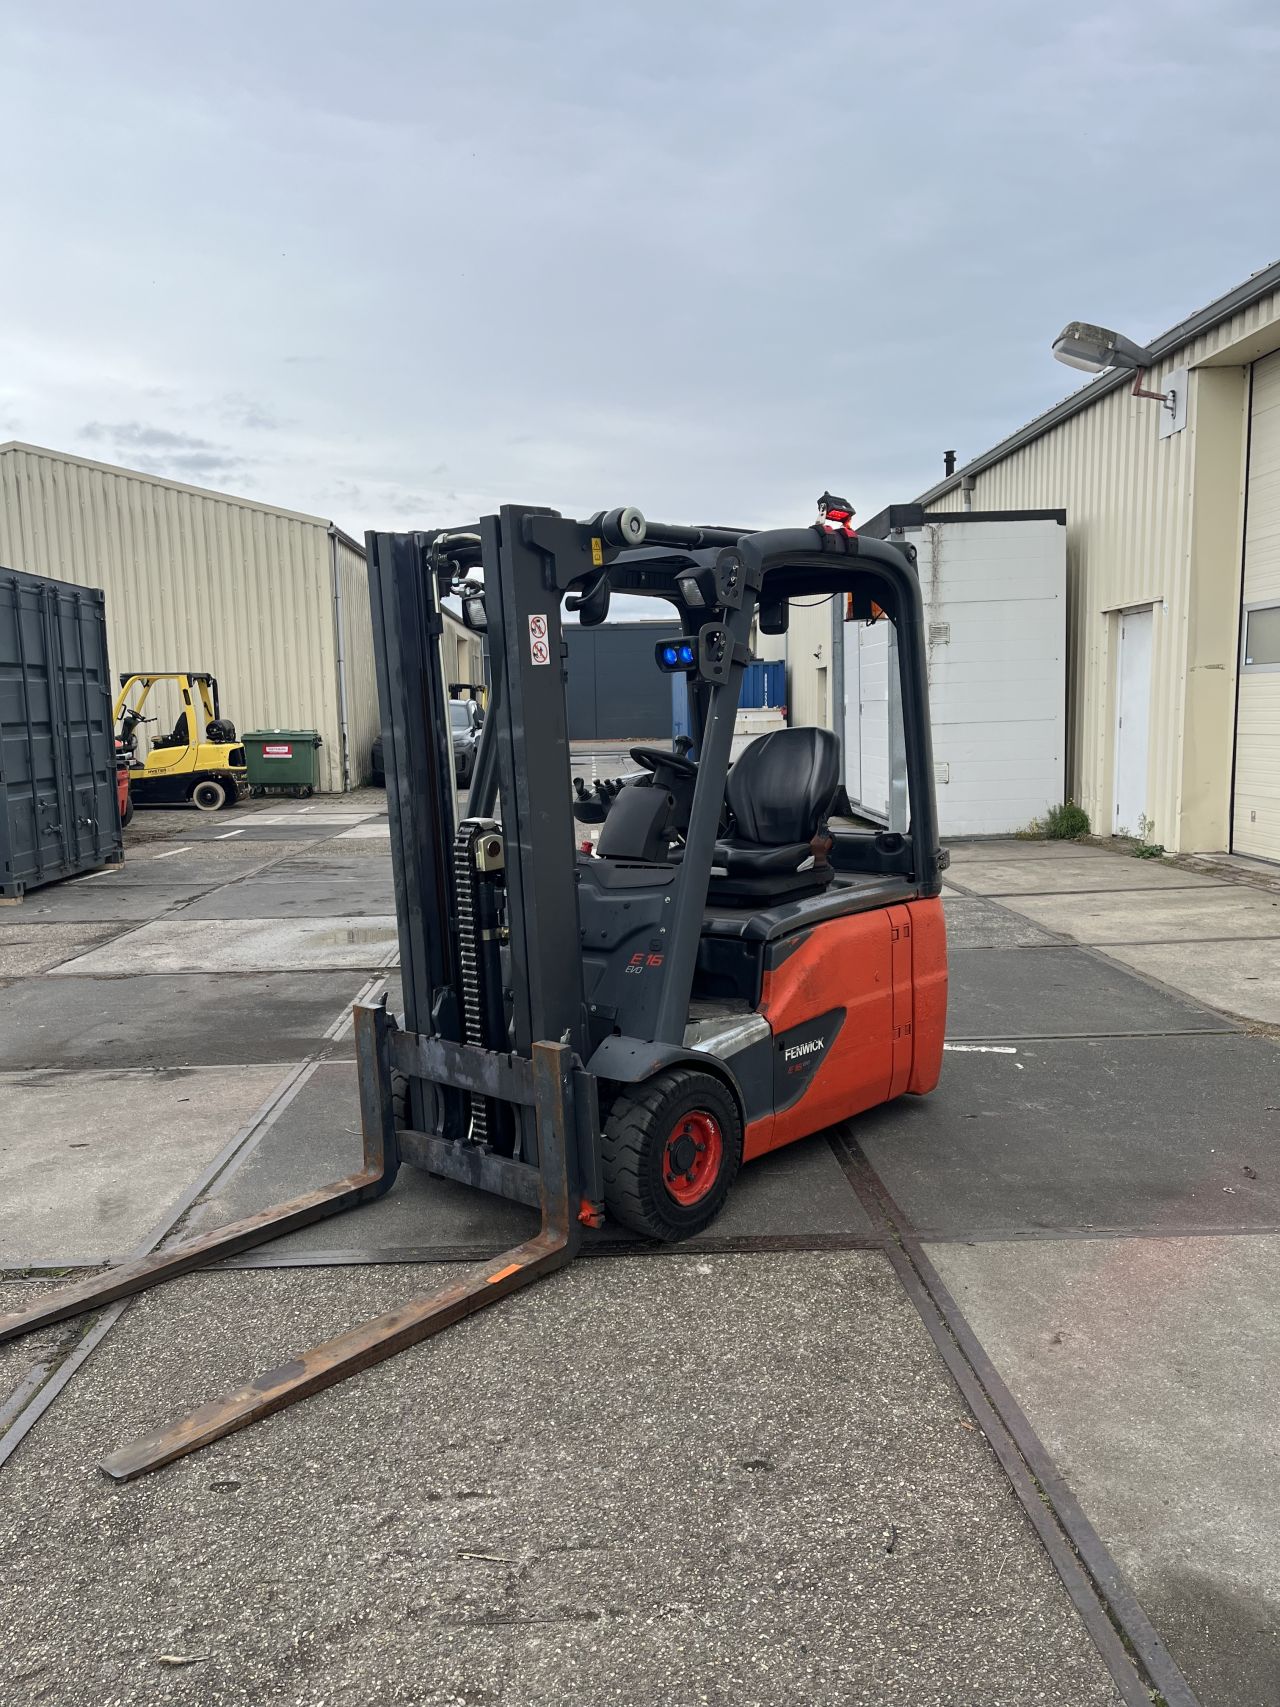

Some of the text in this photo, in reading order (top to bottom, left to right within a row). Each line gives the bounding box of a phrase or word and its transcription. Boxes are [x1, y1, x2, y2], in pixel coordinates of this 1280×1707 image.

[630, 953, 664, 967] E 16
[784, 1036, 824, 1061] FENWICK
